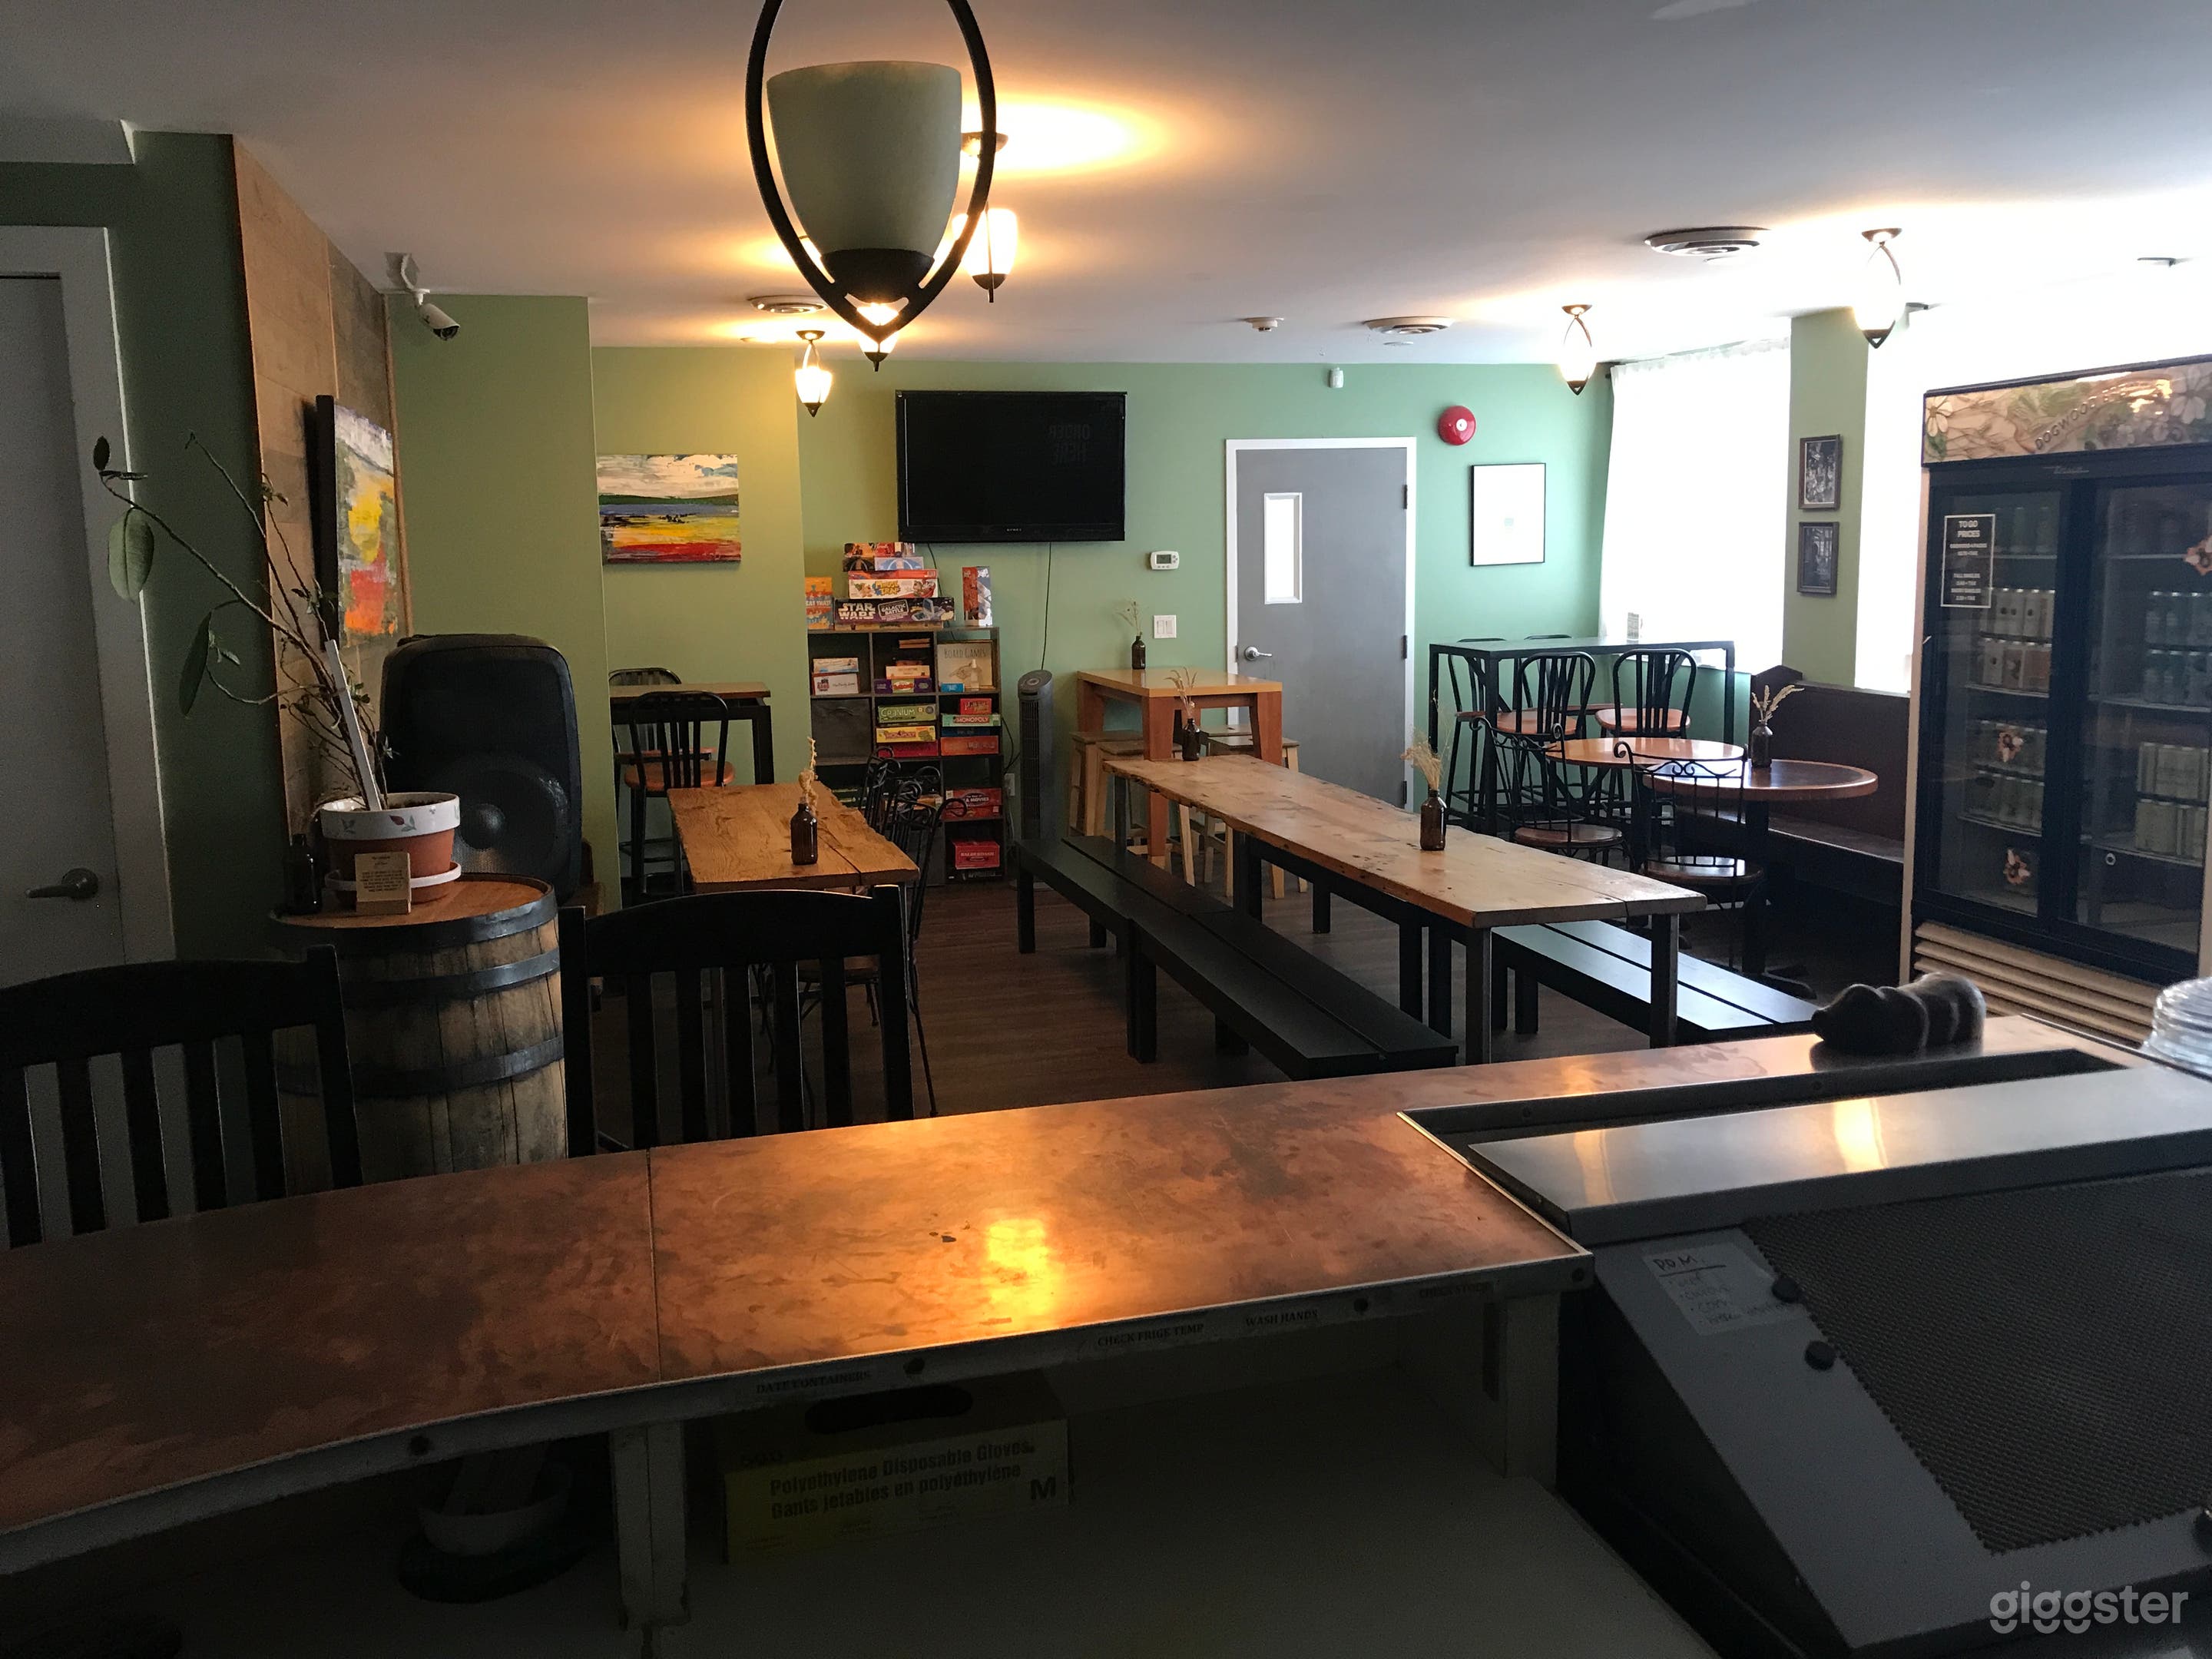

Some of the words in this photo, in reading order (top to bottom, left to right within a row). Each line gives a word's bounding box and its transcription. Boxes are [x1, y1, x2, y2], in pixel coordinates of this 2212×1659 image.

[838, 603, 876, 611] STAR
[838, 611, 876, 619] WARS
[1245, 1314, 1273, 1327] WASH
[1276, 1309, 1319, 1323] HANDS
[1097, 1330, 1134, 1347] CHECK
[1174, 1323, 1204, 1336] TEMP
[756, 1379, 790, 1394] DATE
[791, 1369, 872, 1389] CONTAINERS
[770, 1465, 878, 1497] Polyethylene
[882, 1449, 972, 1477] Disposable
[770, 1497, 819, 1520] Gants
[823, 1485, 890, 1515] jetables
[894, 1479, 915, 1498] en
[1029, 1475, 1057, 1501] M
